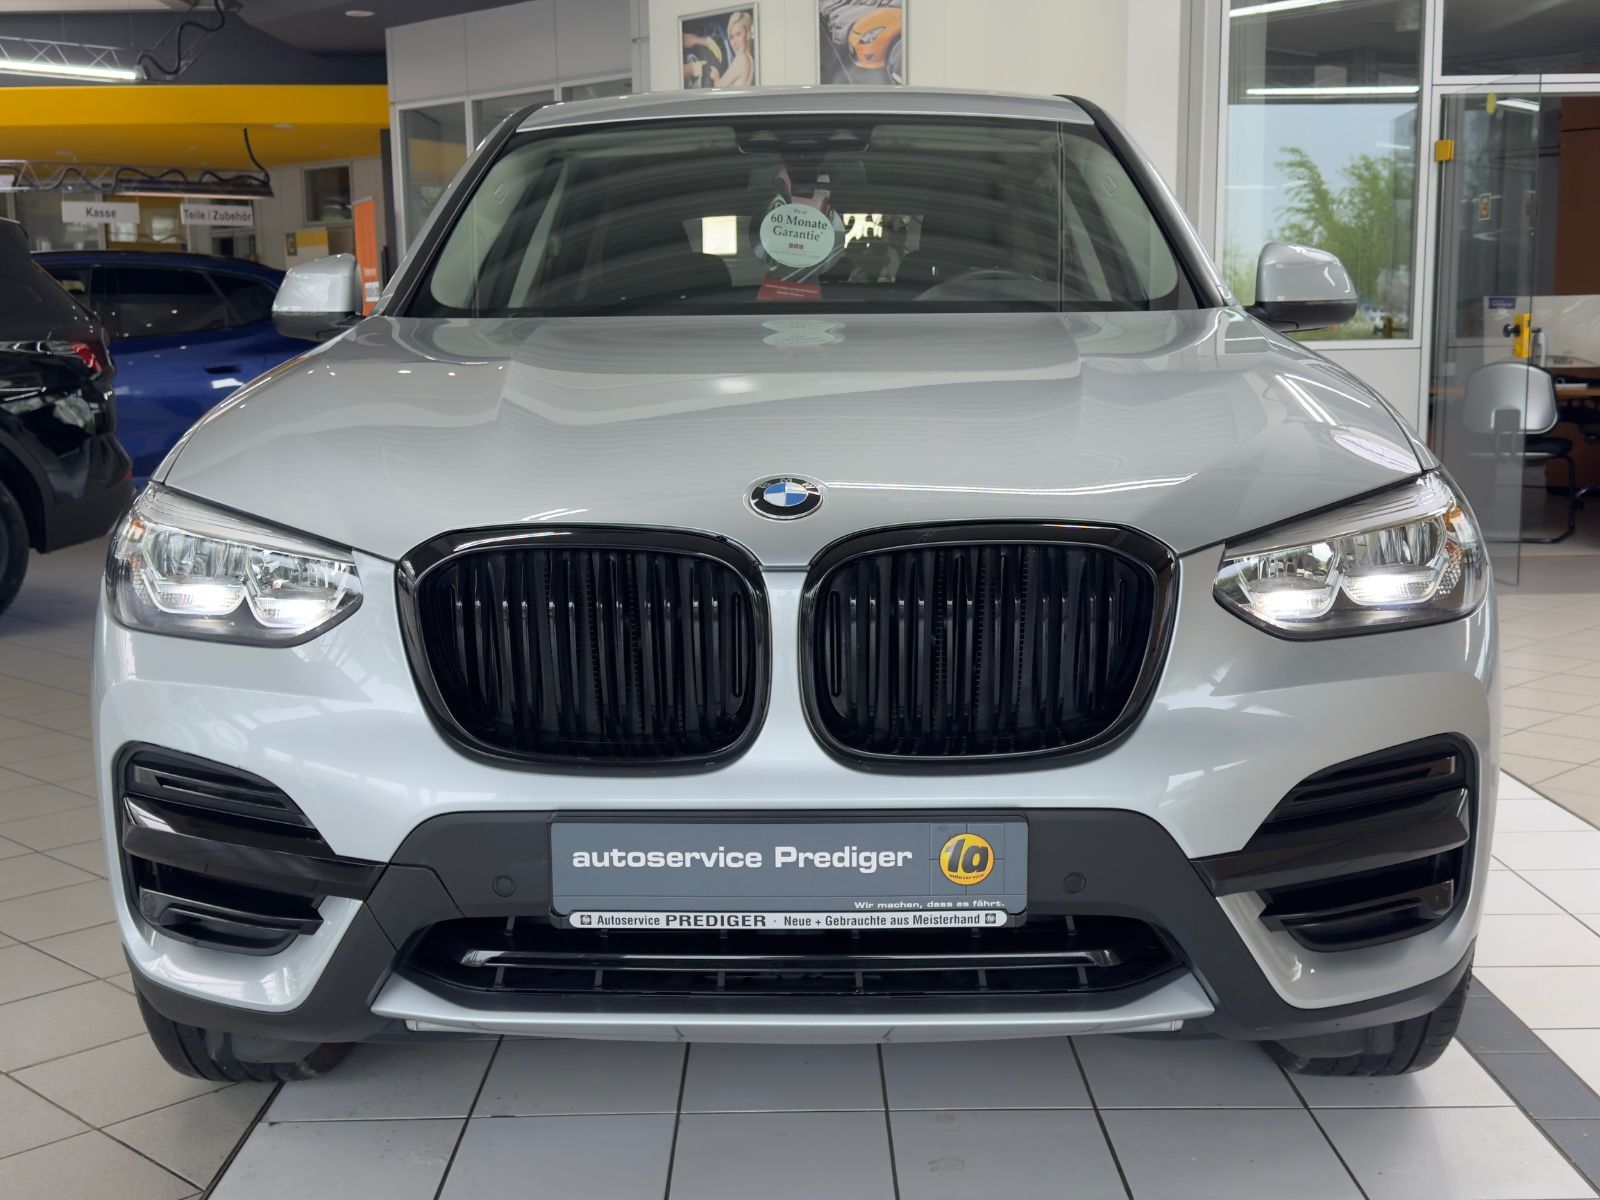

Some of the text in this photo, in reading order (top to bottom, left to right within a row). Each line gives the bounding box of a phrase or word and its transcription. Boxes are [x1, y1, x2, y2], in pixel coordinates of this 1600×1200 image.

[86, 207, 117, 219] Kasse
[184, 209, 206, 219] Teile
[213, 210, 252, 222] Zubehör
[770, 213, 828, 230] 60 Monate
[572, 845, 913, 874] autoservice Prediger
[944, 838, 989, 874] 1a
[854, 901, 874, 909] Wir
[877, 901, 923, 909] machen,
[597, 915, 660, 926] Autoservice
[665, 915, 767, 927] PREDIGER
[784, 915, 812, 926] Neue
[825, 915, 887, 926] Gebrauchte
[890, 916, 909, 926] aus
[913, 914, 980, 925] Meisterhand
